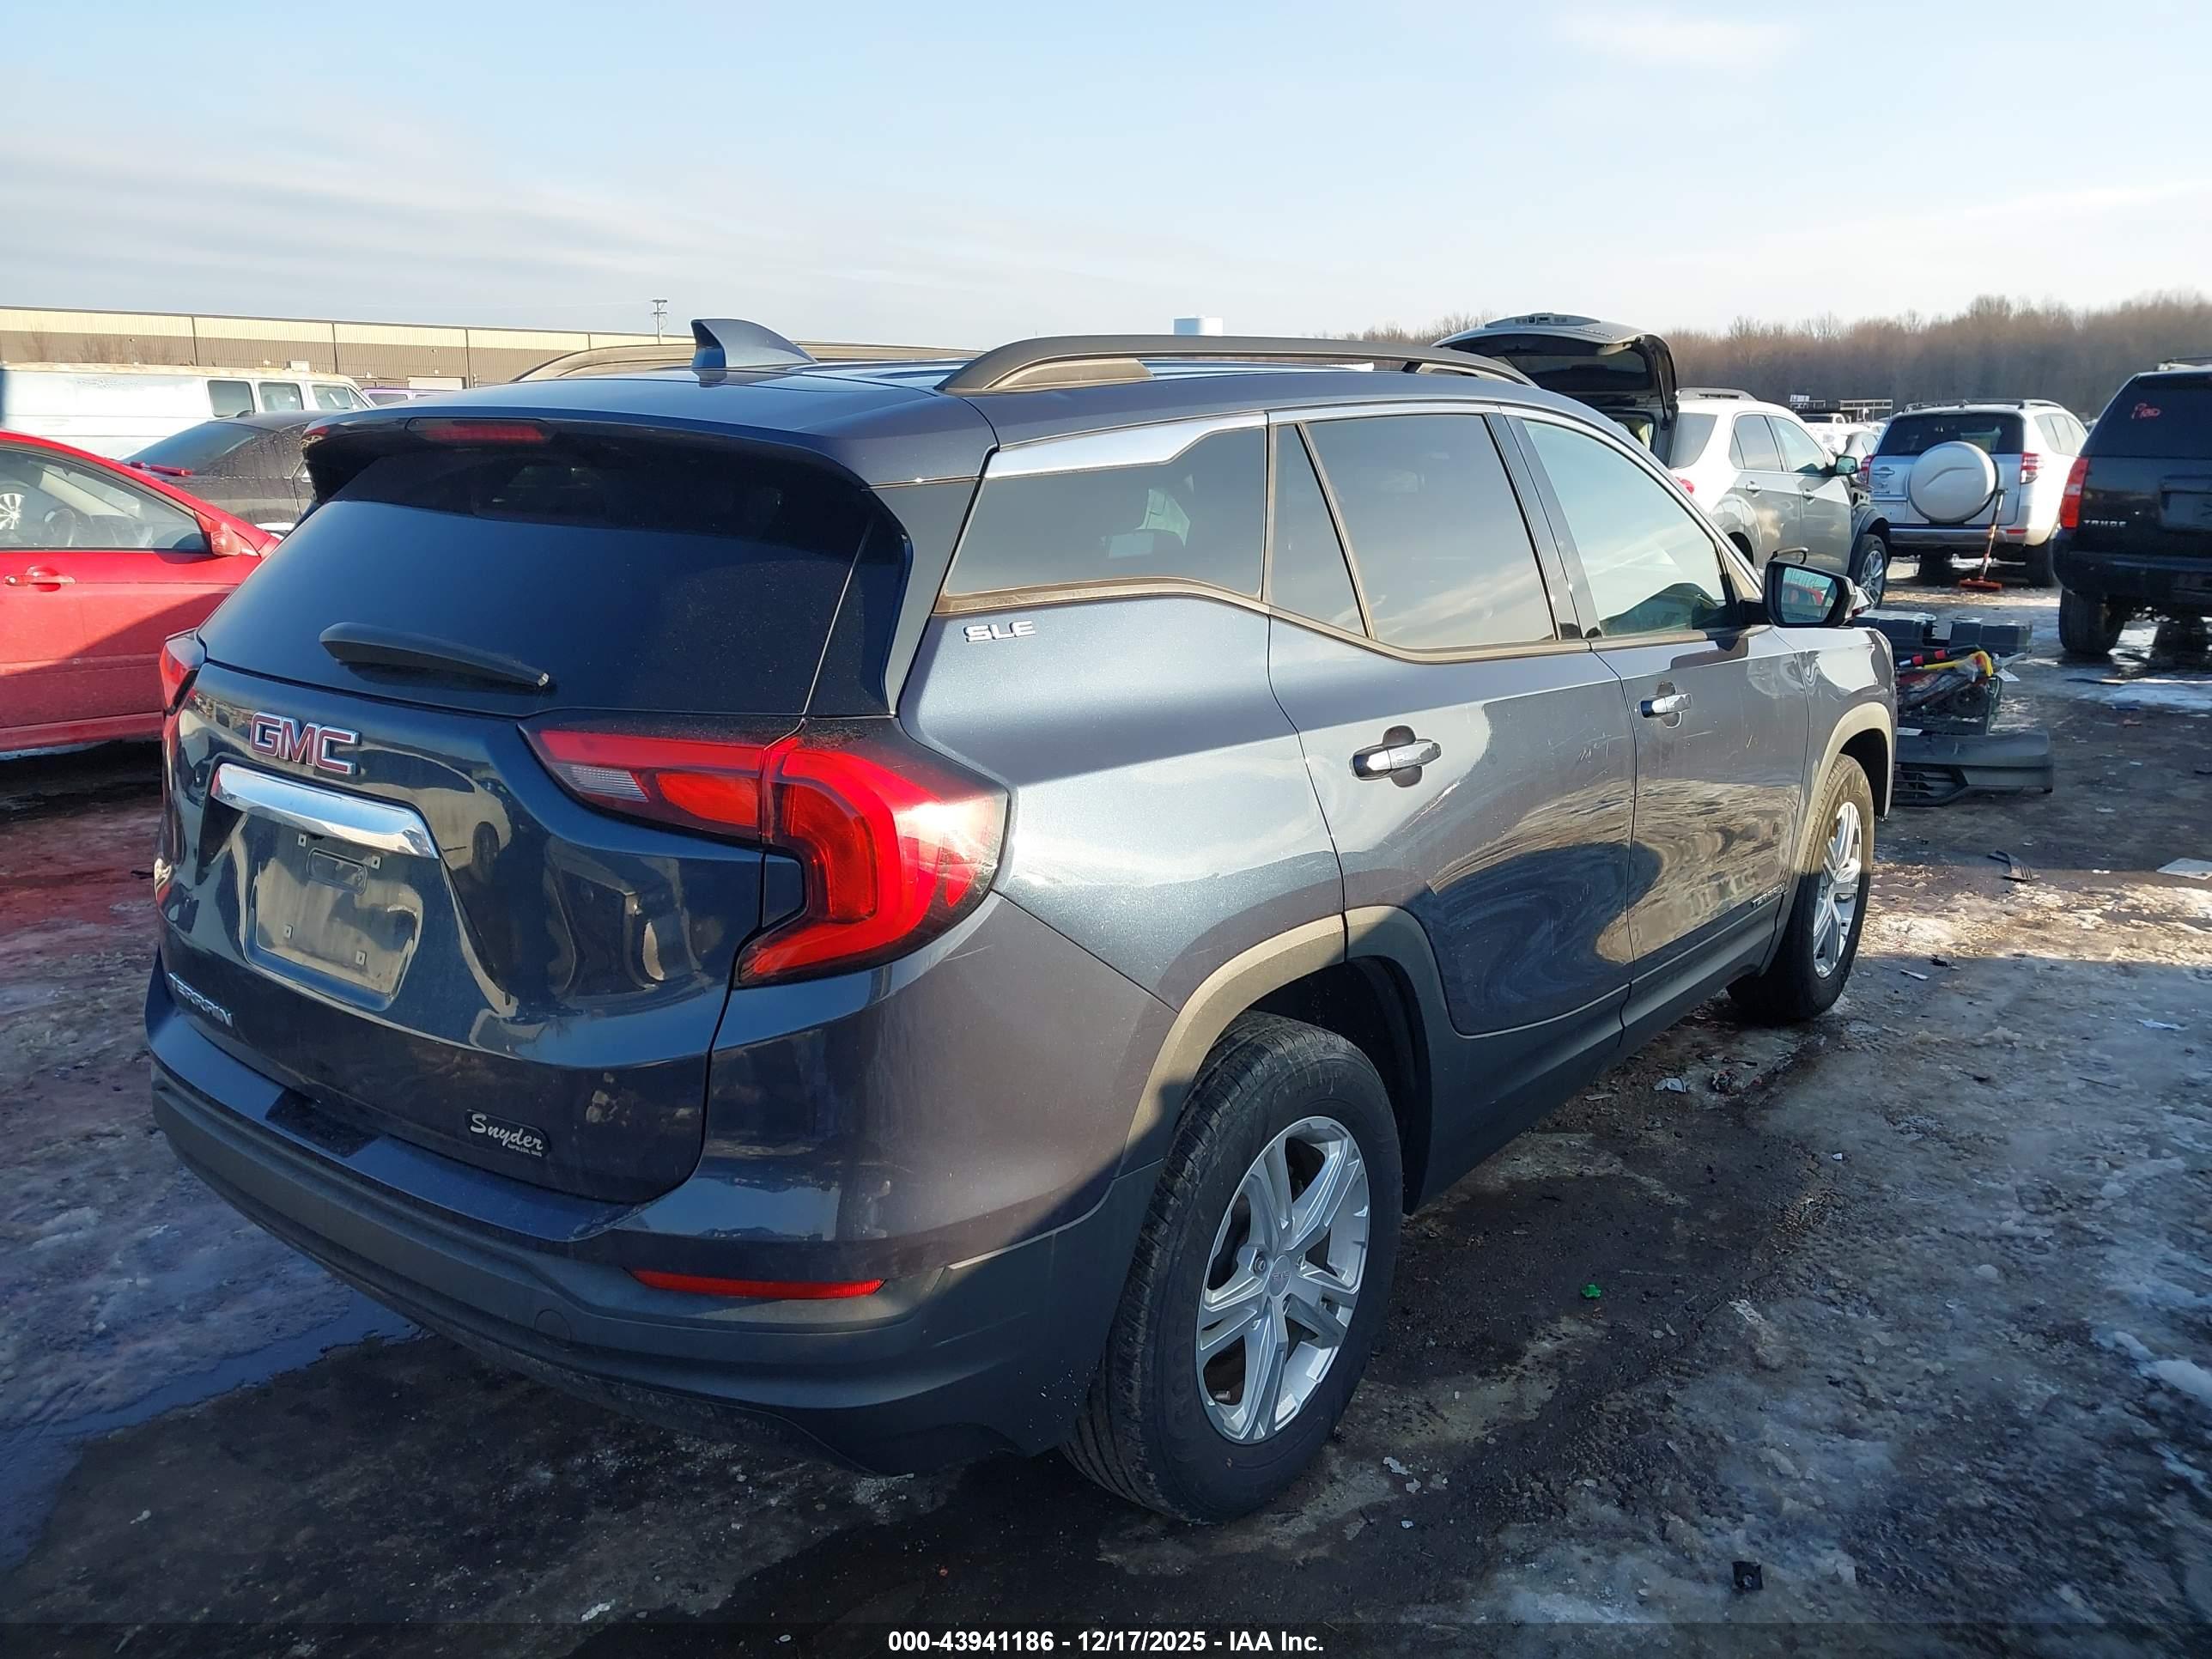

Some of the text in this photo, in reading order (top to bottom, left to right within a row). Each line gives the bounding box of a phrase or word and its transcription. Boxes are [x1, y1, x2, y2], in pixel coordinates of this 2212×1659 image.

[963, 620, 1036, 642] SLE
[250, 711, 359, 775] GMC
[470, 1113, 544, 1151] Snyder
